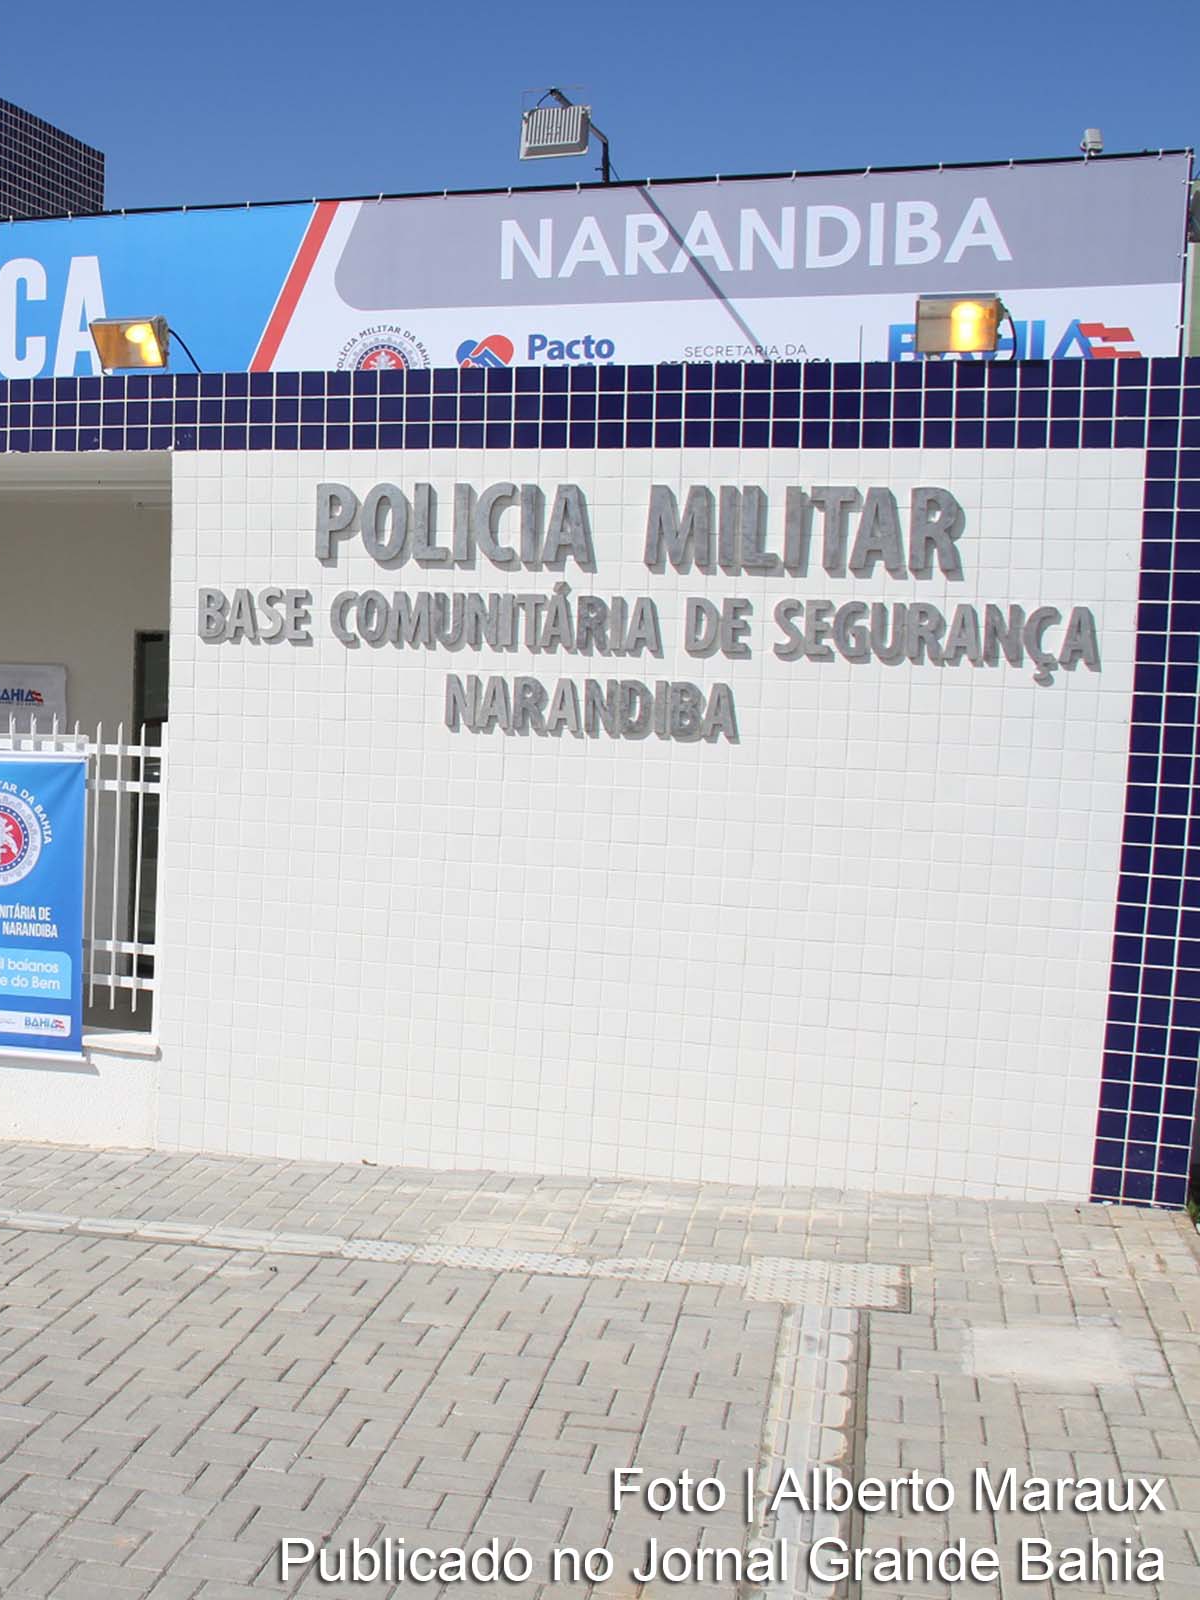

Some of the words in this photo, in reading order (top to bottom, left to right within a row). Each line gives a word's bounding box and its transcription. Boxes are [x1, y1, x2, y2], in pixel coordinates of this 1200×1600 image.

[501, 197, 1012, 280] NARANDIBA
[336, 337, 358, 370] OLÍCIA
[359, 324, 402, 339] MILITAR
[403, 331, 417, 343] DA
[527, 333, 616, 361] Pacto
[684, 344, 780, 358] SECRETARIA
[784, 343, 808, 356] DA
[315, 482, 597, 573] POLICIA
[643, 484, 966, 581] MILITAR
[198, 587, 314, 647] BASE
[329, 581, 664, 659] COMUNITÁRIA
[685, 597, 754, 660] DE
[773, 598, 1102, 687] SEGURANÇA
[445, 673, 741, 745] NARANDIBA
[20, 789, 35, 806] DA
[33, 804, 53, 845] BAHIA
[2, 921, 58, 939] NARANDIBA
[38, 906, 52, 921] DE
[10, 975, 29, 988] do
[31, 976, 61, 991] Bem
[24, 1016, 58, 1028] BAHIA
